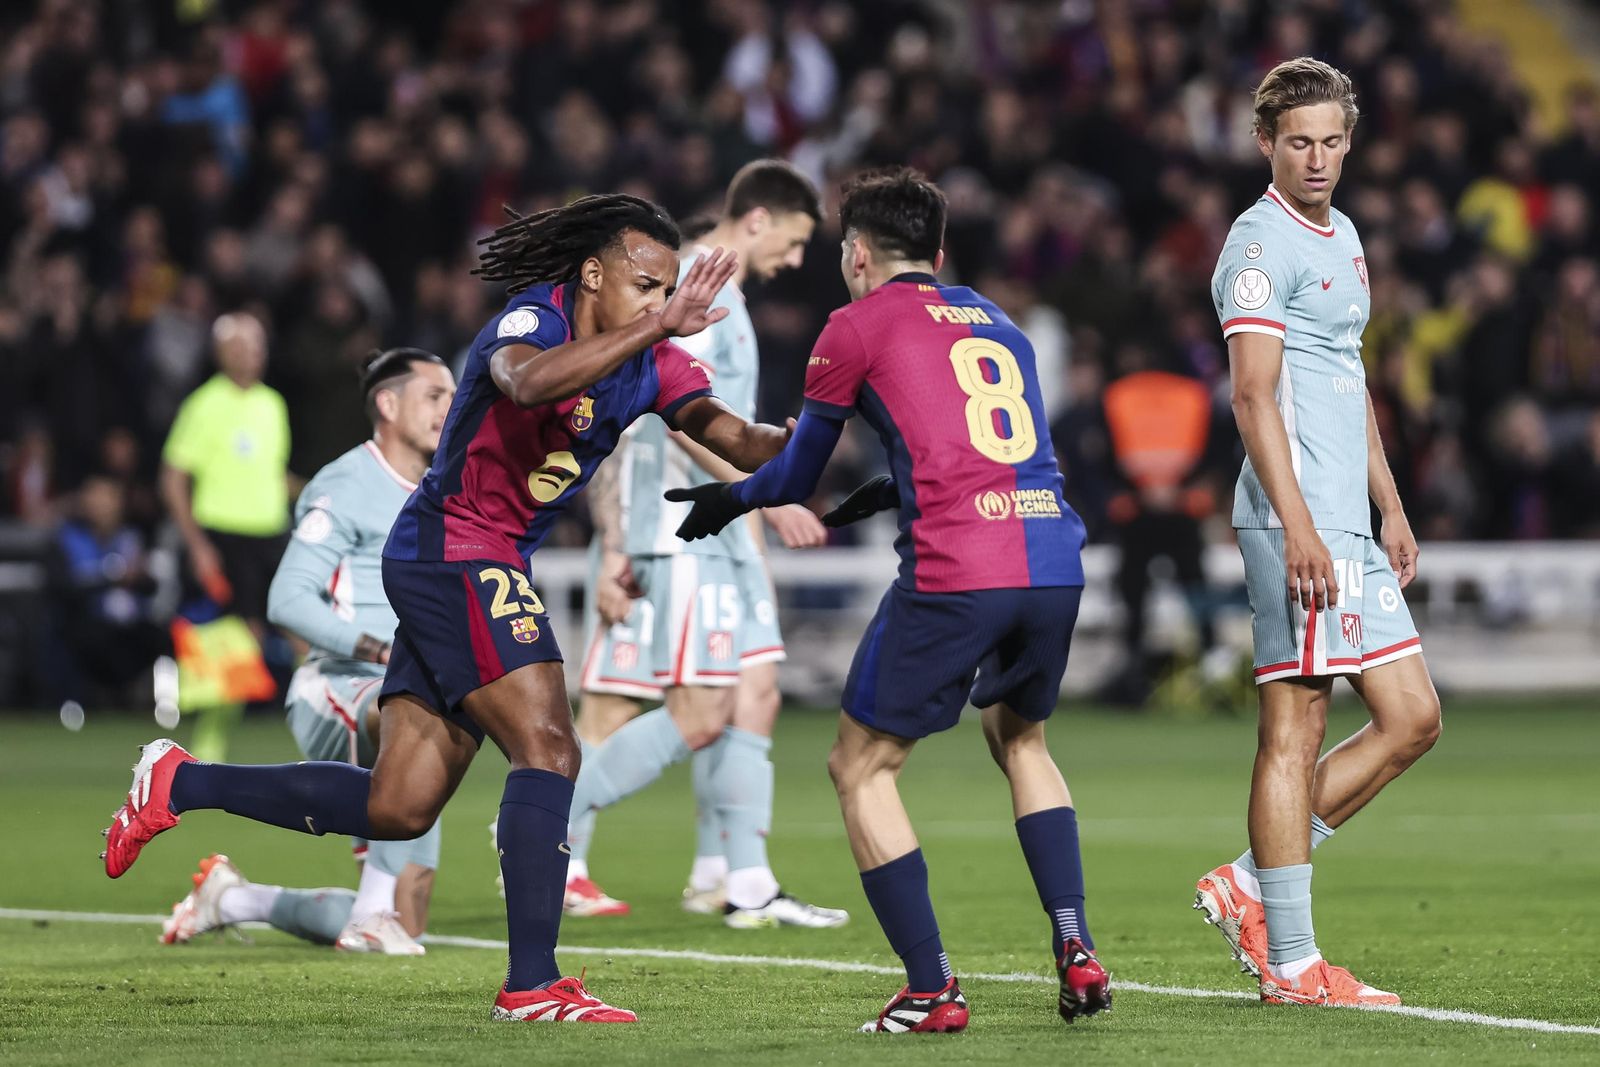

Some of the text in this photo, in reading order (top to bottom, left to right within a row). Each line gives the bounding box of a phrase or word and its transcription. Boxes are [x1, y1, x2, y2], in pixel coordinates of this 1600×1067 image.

[924, 304, 993, 324] PEDRI
[949, 337, 1037, 464] 8
[1010, 488, 1056, 502] UNHCR
[1014, 500, 1061, 513] ACNUR
[478, 567, 545, 619] 23
[699, 583, 740, 629] 15
